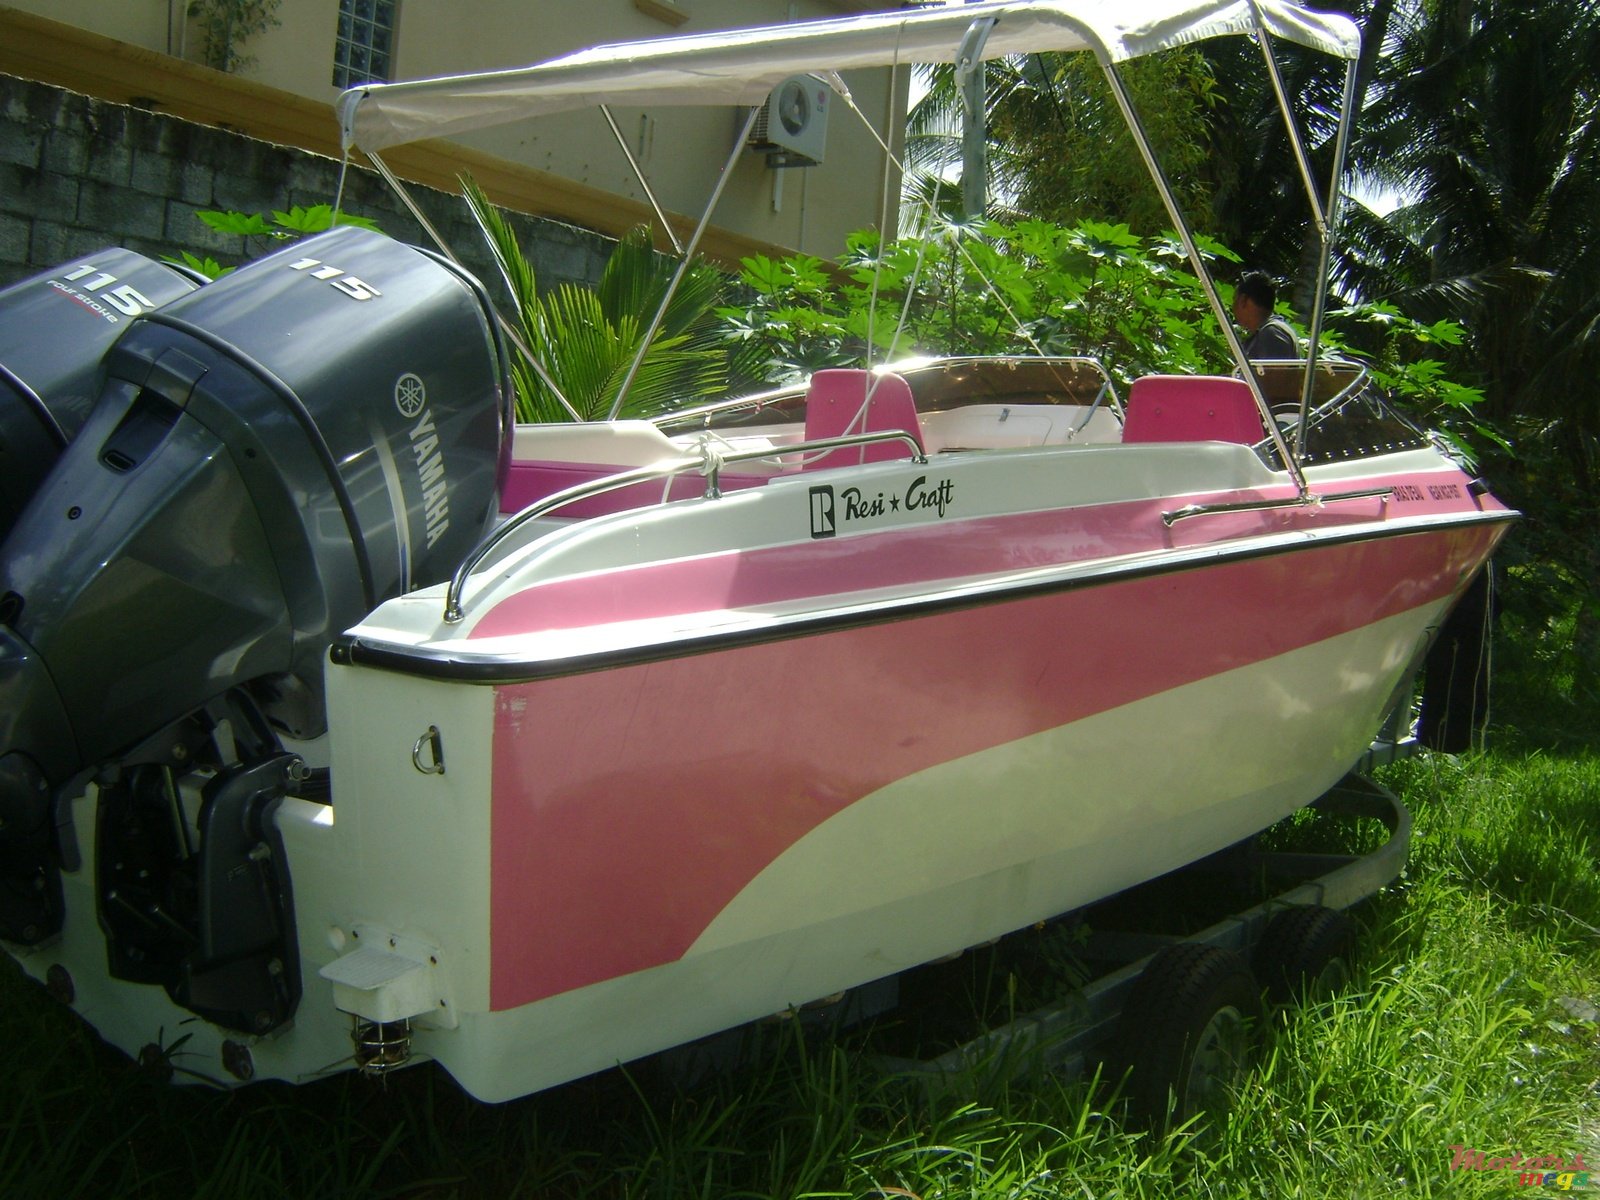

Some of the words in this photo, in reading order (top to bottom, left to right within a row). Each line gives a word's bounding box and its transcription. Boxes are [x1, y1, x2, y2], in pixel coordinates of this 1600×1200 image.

[64, 264, 156, 317] 115
[288, 257, 382, 300] 115
[408, 409, 449, 550] YAMAHA
[840, 487, 885, 520] Resi
[905, 476, 954, 518] Craft
